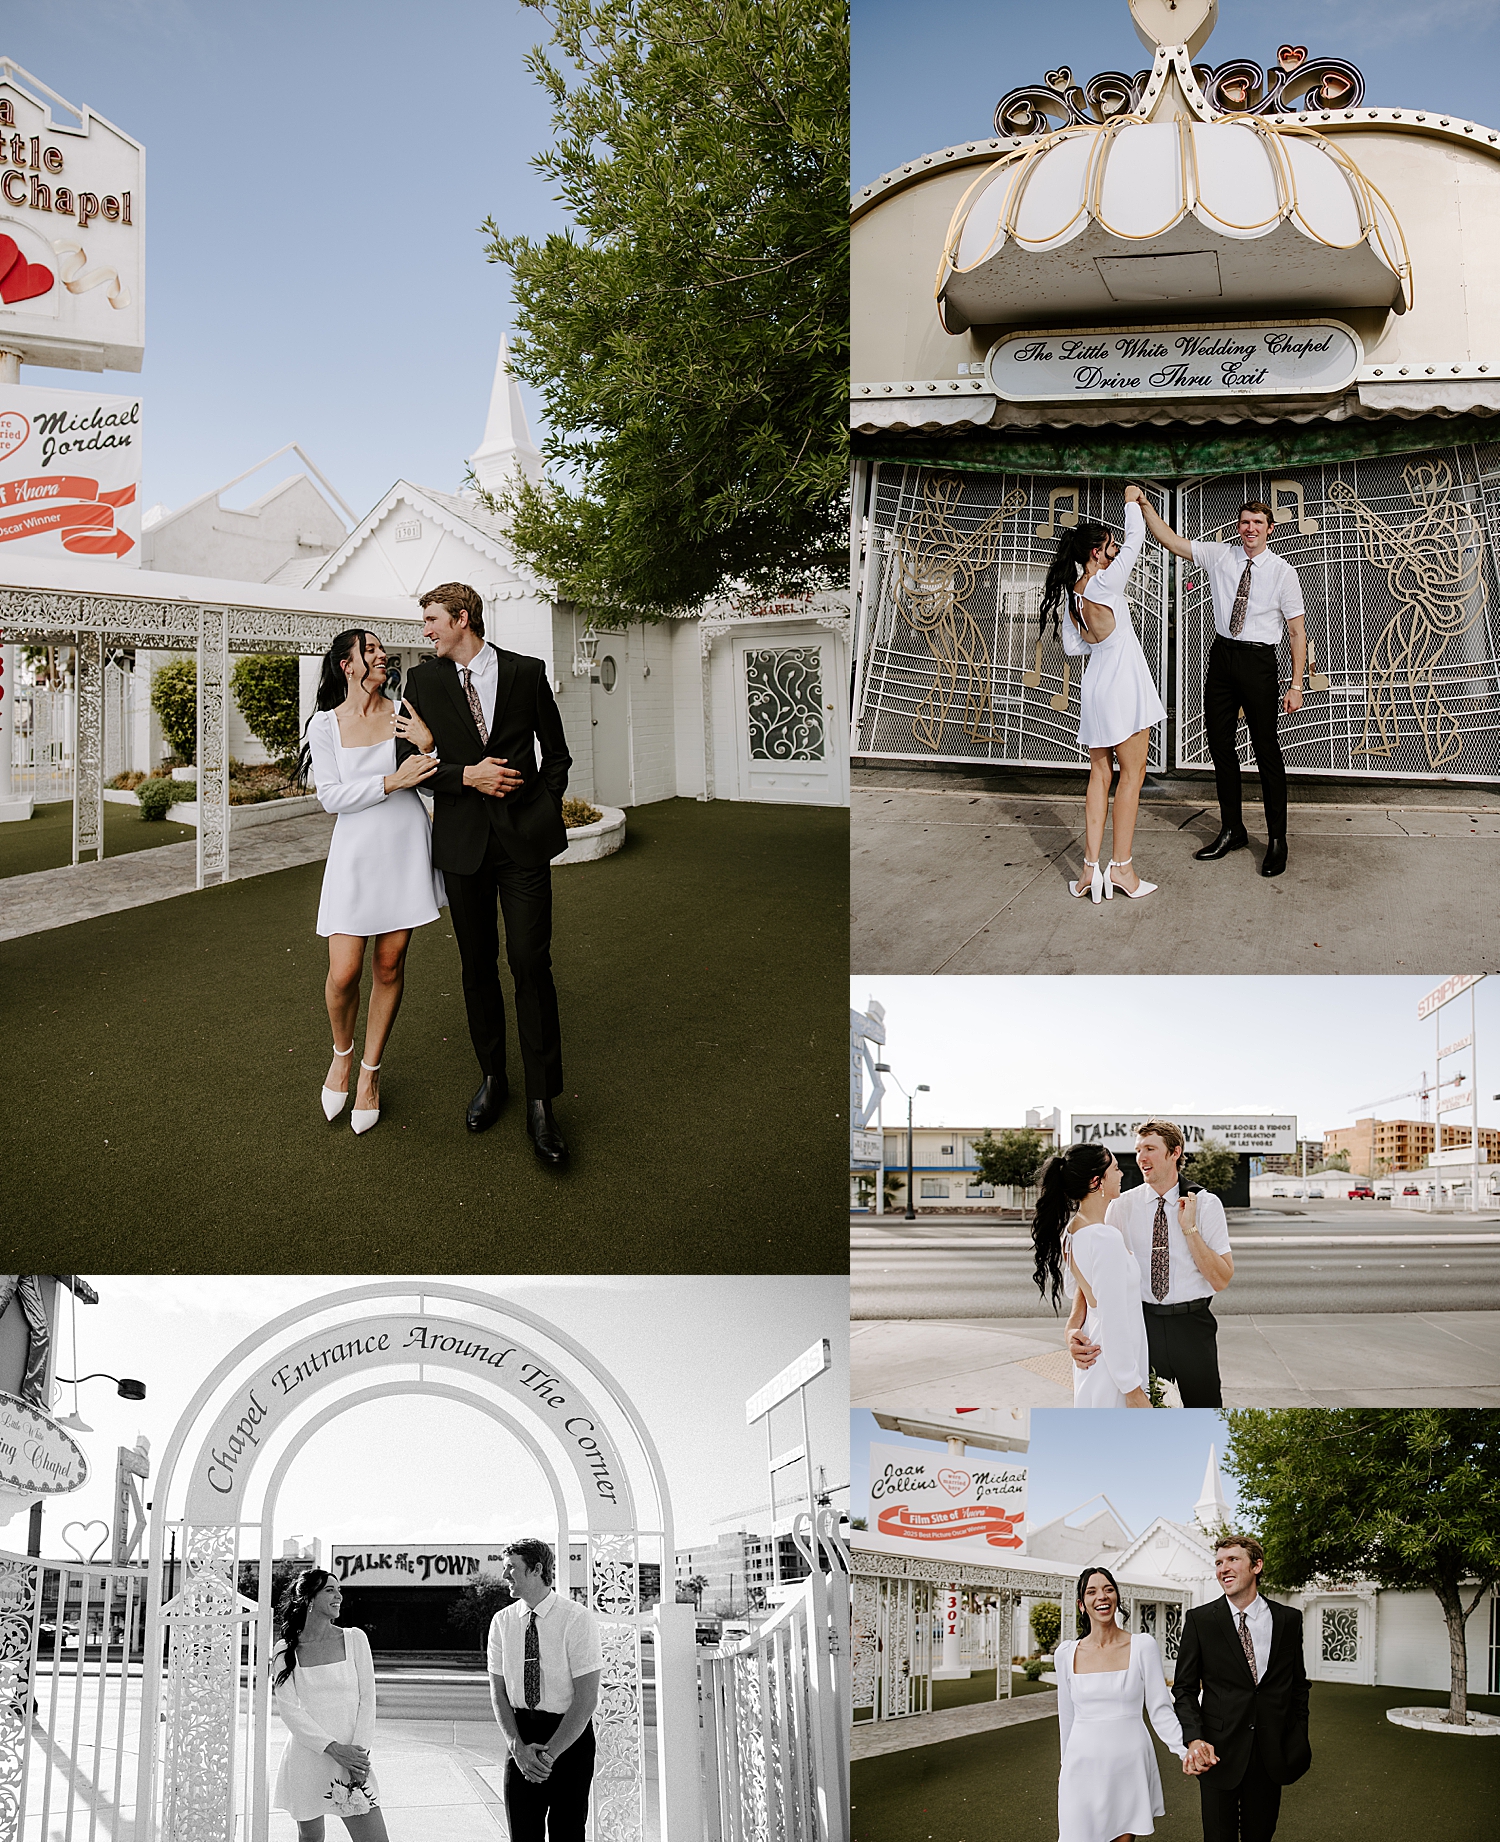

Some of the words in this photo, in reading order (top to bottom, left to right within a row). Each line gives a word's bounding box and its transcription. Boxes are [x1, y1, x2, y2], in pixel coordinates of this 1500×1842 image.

[1, 169, 133, 228] Chapel
[1013, 341, 1054, 362] The
[1058, 340, 1110, 361] Little
[1115, 337, 1169, 359] White
[1174, 335, 1257, 362] Wedding
[1263, 333, 1334, 358] Chapel
[1073, 365, 1141, 390] Drive
[1149, 362, 1213, 388] Thru
[1220, 362, 1269, 387] Exit
[33, 402, 140, 435] Michael
[41, 430, 132, 467] Jordan
[23, 514, 61, 529] Winner
[751, 603, 799, 616] CHAPEL
[1418, 975, 1473, 1017] STRIPPE
[852, 1031, 865, 1129] MOTEL
[1074, 1122, 1127, 1143] TALK
[207, 1388, 268, 1496] Chapel
[270, 1332, 391, 1395] Entrance
[402, 1326, 517, 1369] Around
[519, 1362, 567, 1410] The
[564, 1416, 618, 1505] Corner
[23, 1439, 71, 1481] Chapel
[884, 1463, 925, 1485] Joan
[972, 1469, 1026, 1485] Michael
[871, 1477, 938, 1500] Collins
[976, 1483, 1023, 1501] Jordan
[909, 1514, 931, 1525] Film
[930, 1512, 949, 1525] Site
[949, 1510, 959, 1521] of
[903, 1530, 918, 1538] 2025
[918, 1531, 932, 1539] Best
[932, 1531, 952, 1539] Picture
[951, 1528, 967, 1537] Oscar
[966, 1524, 987, 1533] Winner
[334, 1553, 392, 1582] TALK
[394, 1559, 414, 1574] THE
[396, 1552, 409, 1563] OF
[416, 1554, 480, 1581] TOWN
